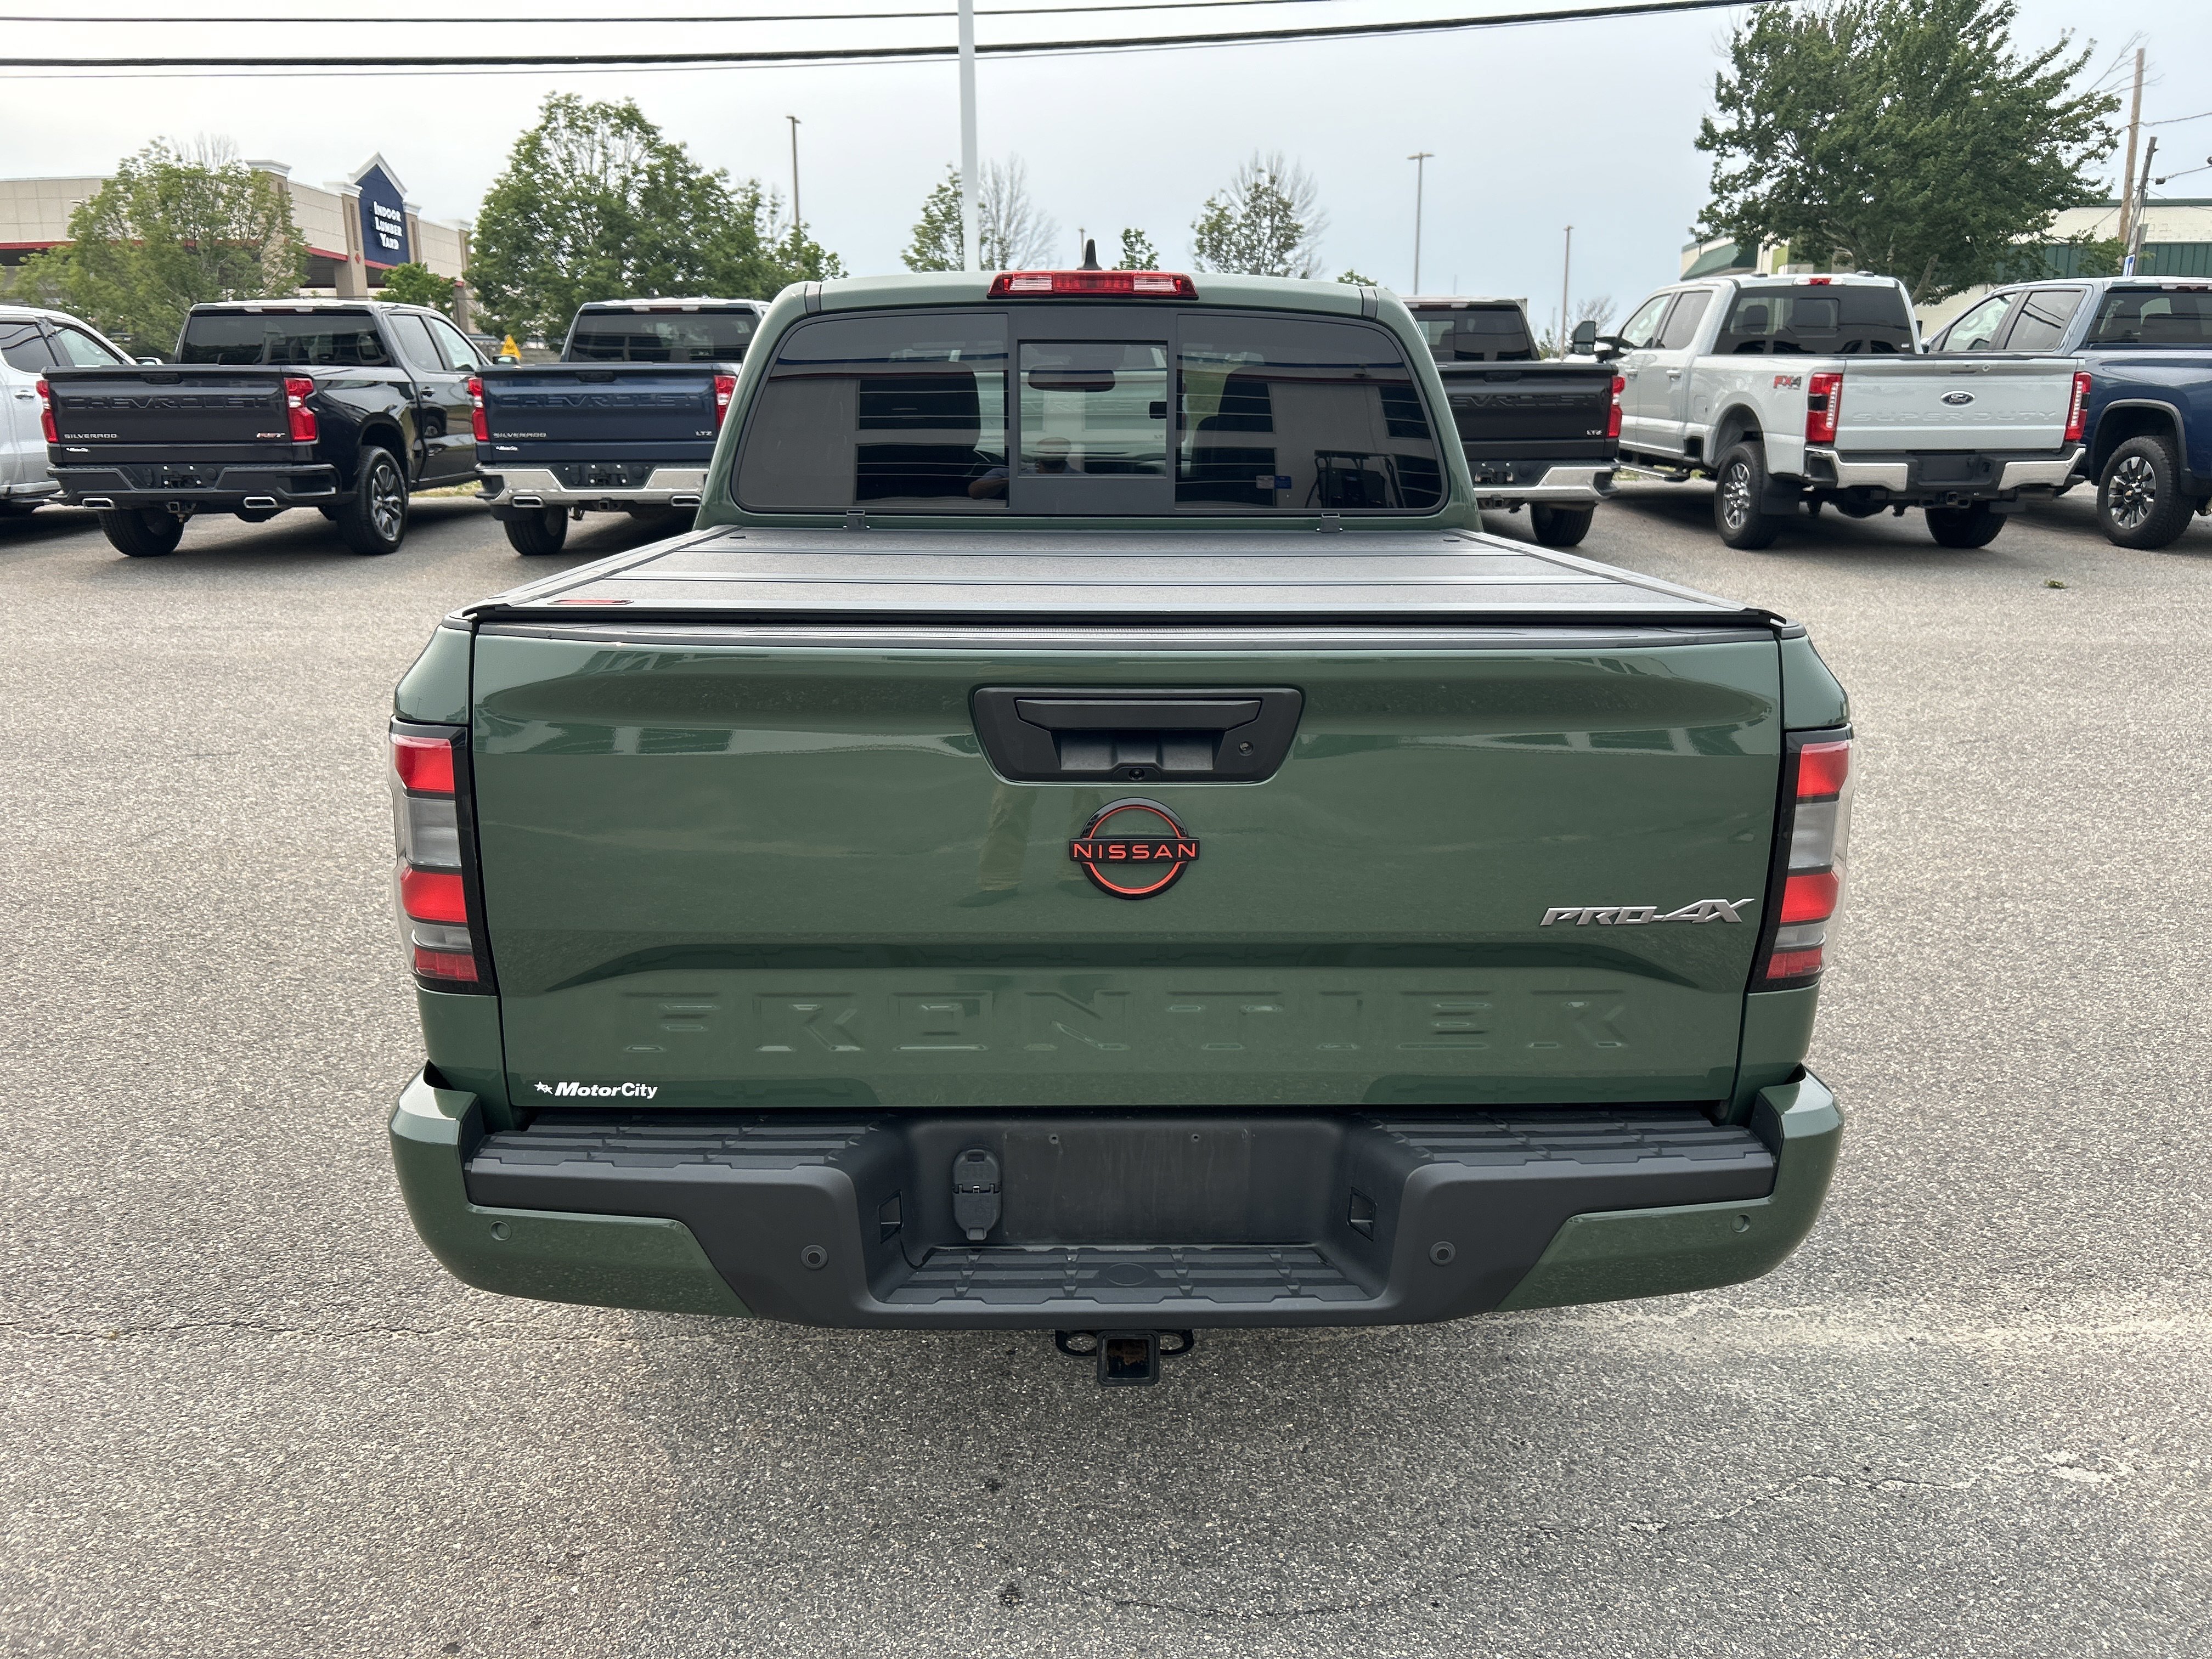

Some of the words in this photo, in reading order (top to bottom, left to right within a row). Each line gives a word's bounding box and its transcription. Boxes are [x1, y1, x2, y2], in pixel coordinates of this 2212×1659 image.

[1773, 375, 1802, 389] FX4
[63, 397, 269, 409] CHEVROLET
[500, 395, 699, 408] CHEVROLET
[1450, 394, 1596, 407] EVROLET
[1853, 411, 1963, 422] SUPER
[1972, 411, 2057, 422] DUTY
[1074, 843, 1196, 859] NISSAN
[1539, 898, 1756, 926] PRO-4X
[621, 990, 1628, 1052] FRONTIER
[554, 1082, 658, 1099] MotorCity
